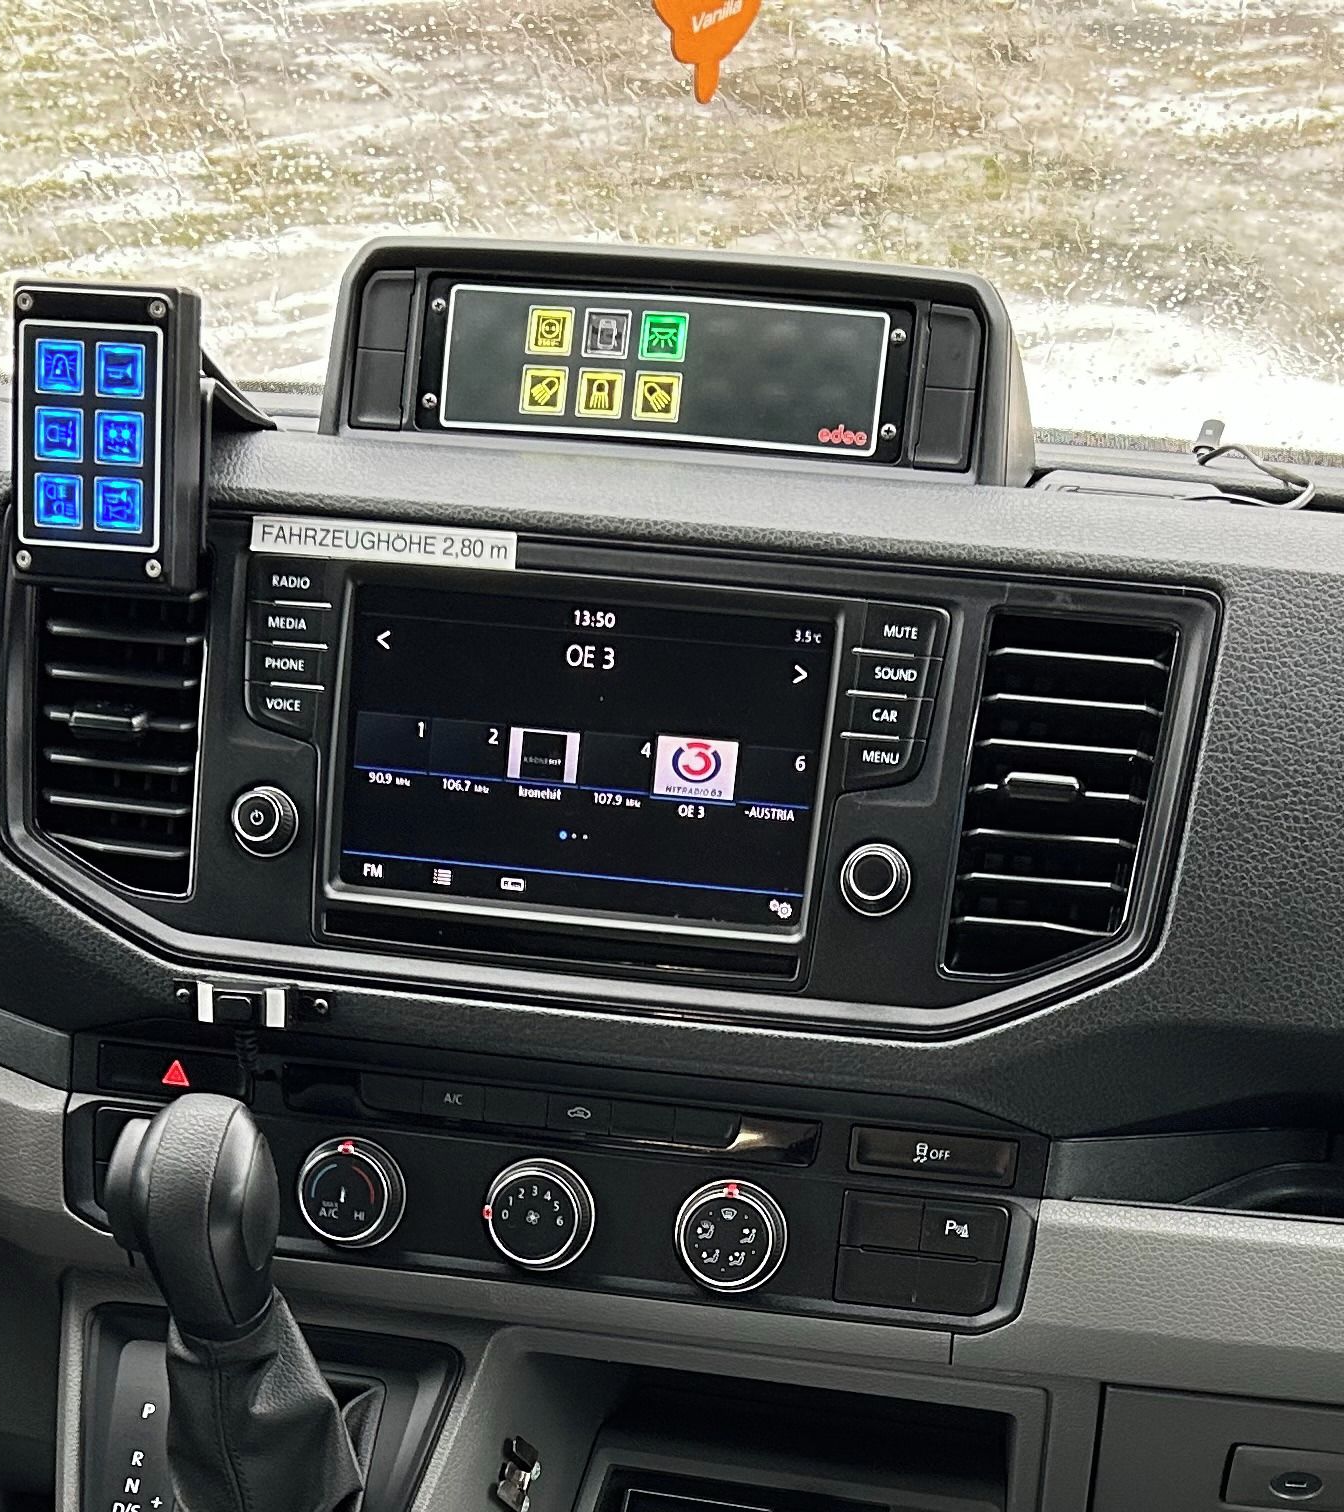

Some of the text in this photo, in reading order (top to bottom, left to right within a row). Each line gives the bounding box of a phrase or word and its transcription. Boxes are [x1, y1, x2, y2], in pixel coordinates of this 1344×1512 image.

[261, 524, 507, 560] FAHRZEUGHÖHE 2,80 m
[272, 574, 311, 589] RADIO
[267, 616, 307, 631] MEDIA
[574, 610, 616, 628] 13:50
[883, 625, 918, 640] MUTE
[265, 657, 305, 672] PHONE
[566, 644, 615, 670] OE 3
[874, 666, 918, 682] SOUND
[266, 697, 302, 712] VOICE
[872, 709, 898, 723] CAR
[418, 721, 425, 738] 1
[488, 728, 499, 745] 2
[640, 742, 652, 758] 4
[862, 750, 900, 765] MENU
[795, 755, 806, 771] 6
[368, 772, 392, 785] 90.9
[442, 778, 471, 792] 106.7
[593, 792, 623, 806] 107.9
[677, 804, 705, 819] OE 3
[363, 862, 383, 878] FM
[443, 1093, 463, 1105] A/C
[929, 1149, 951, 1160] OFF
[518, 1187, 525, 1199] 2
[531, 1185, 538, 1196] 3
[543, 1190, 551, 1201] 4
[508, 1196, 513, 1206] 1
[553, 1200, 560, 1212] 5
[319, 1208, 339, 1220] A/C
[354, 1211, 365, 1221] HI
[501, 1209, 509, 1220] 0
[556, 1216, 564, 1226] 6
[142, 1402, 156, 1419] P
[131, 1451, 144, 1467] R
[124, 1477, 141, 1494] N
